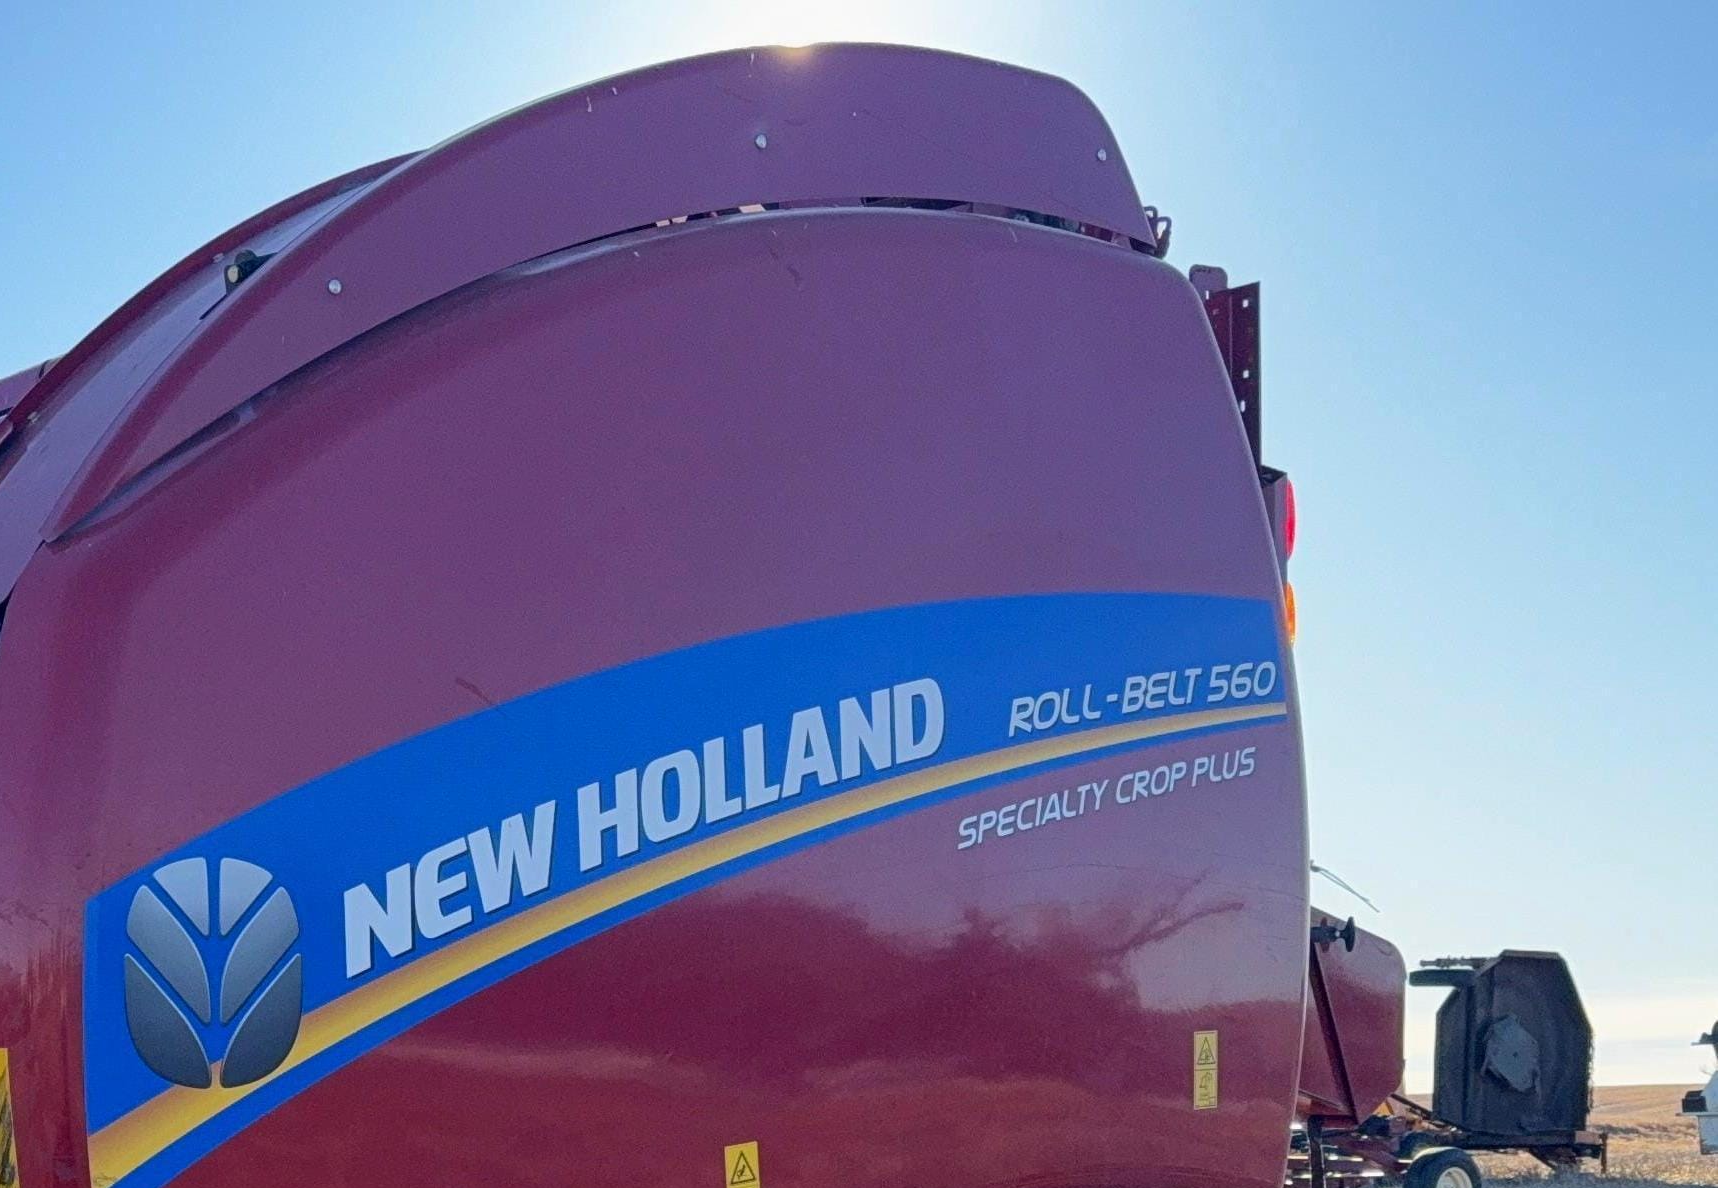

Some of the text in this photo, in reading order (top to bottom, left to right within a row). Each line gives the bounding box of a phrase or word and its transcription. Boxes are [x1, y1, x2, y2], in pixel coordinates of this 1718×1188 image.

[1008, 661, 1277, 737] ROLL-BELT 560
[343, 677, 946, 979] NEW HOLLAND
[957, 746, 1256, 850] SPECIALTY CROP PLUS
